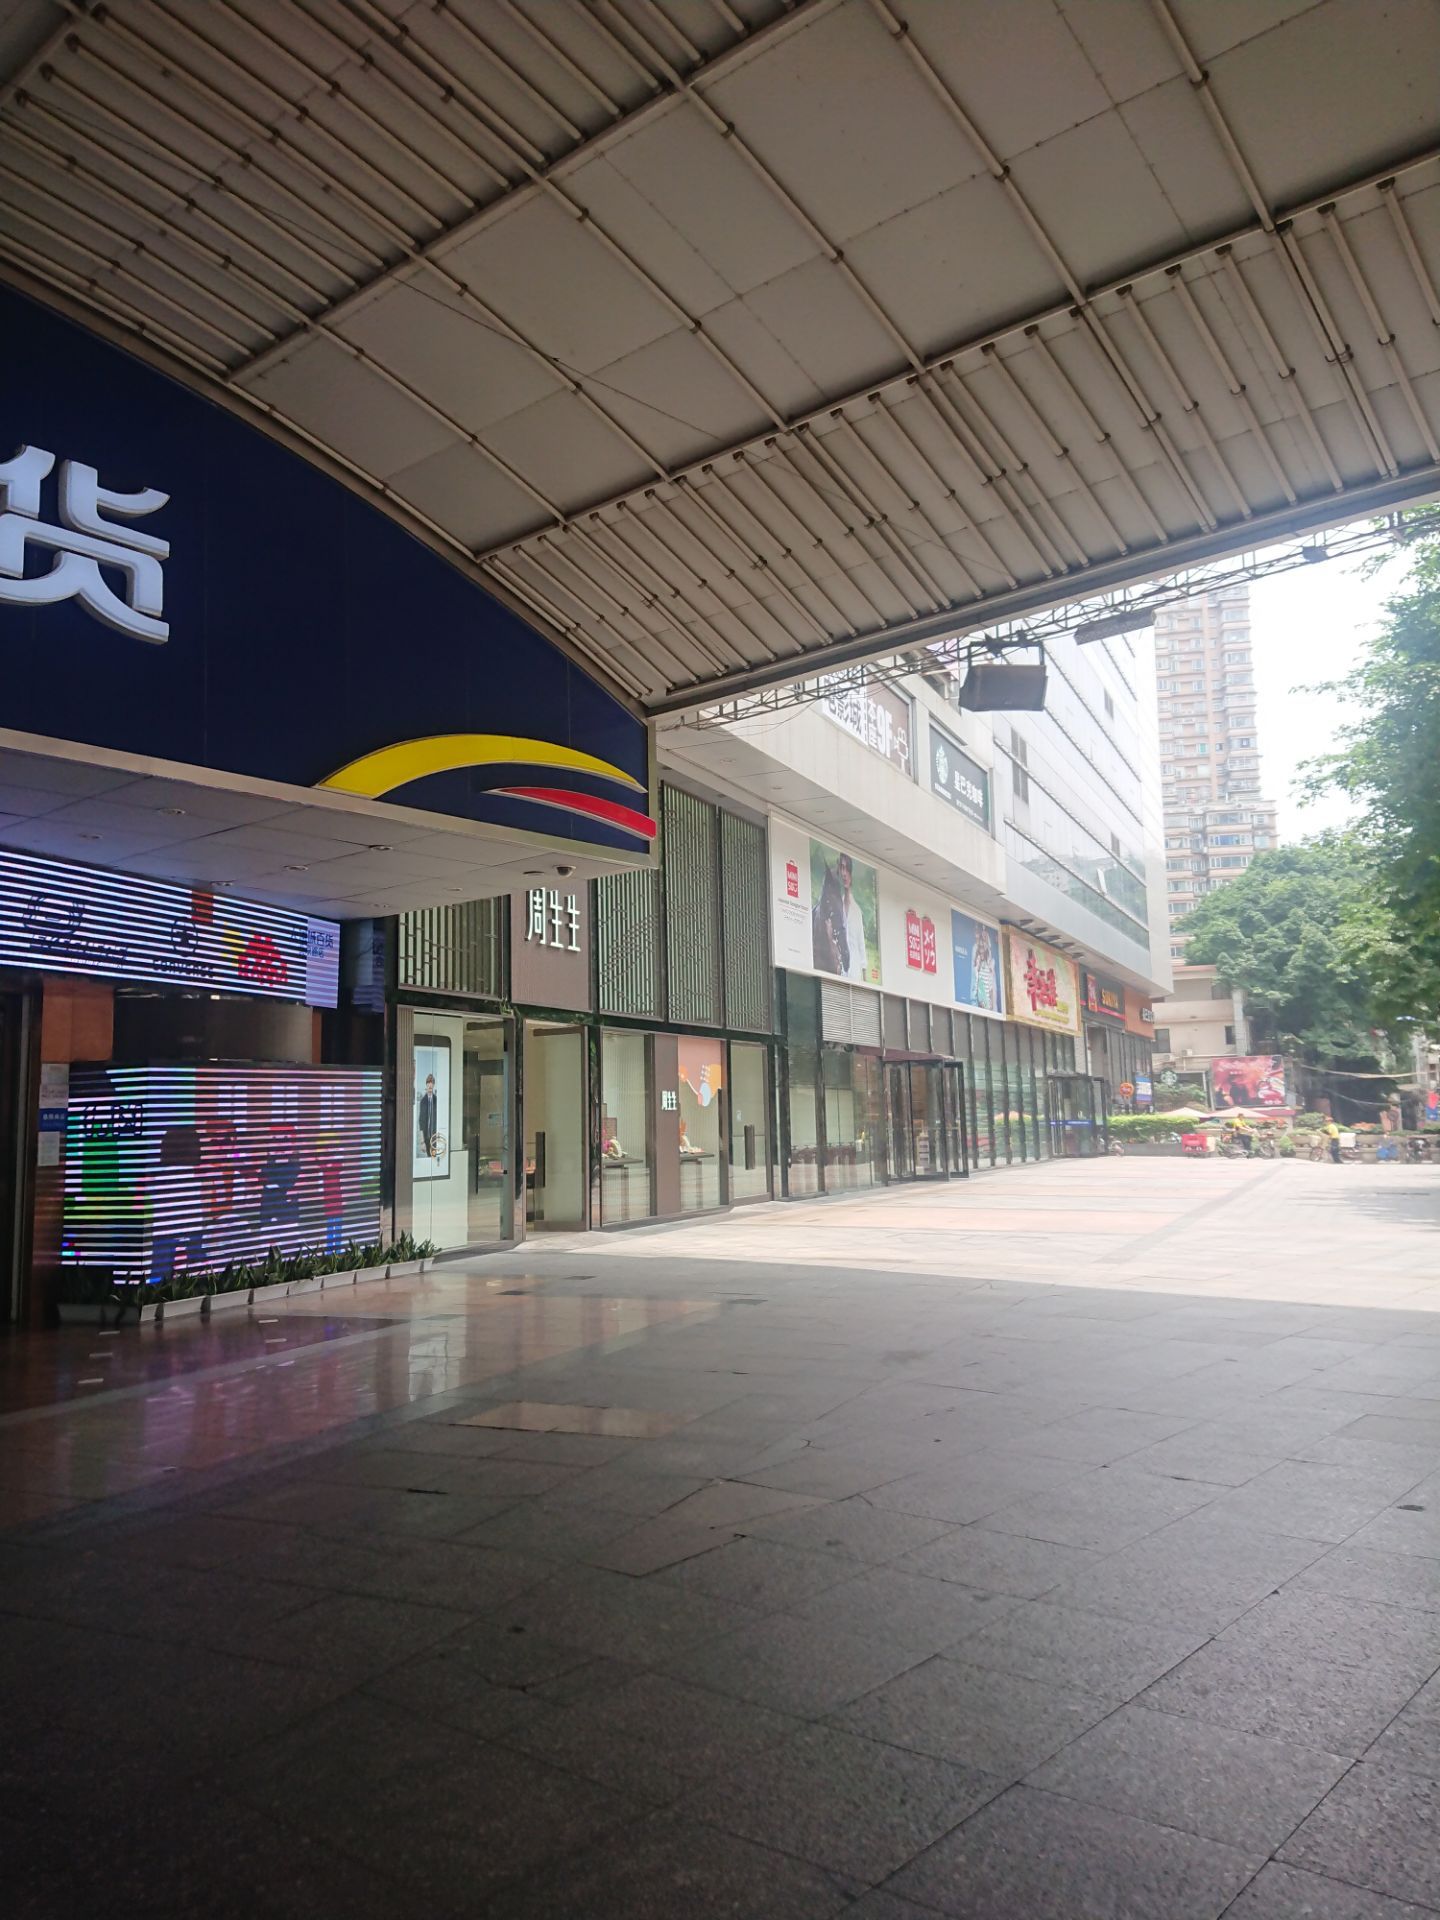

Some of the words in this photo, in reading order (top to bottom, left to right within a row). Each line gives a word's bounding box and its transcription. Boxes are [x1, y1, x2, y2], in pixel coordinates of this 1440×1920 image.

[0, 445, 171, 644] 货
[526, 887, 581, 952] 周生生
[661, 1090, 677, 1111] 周生生
